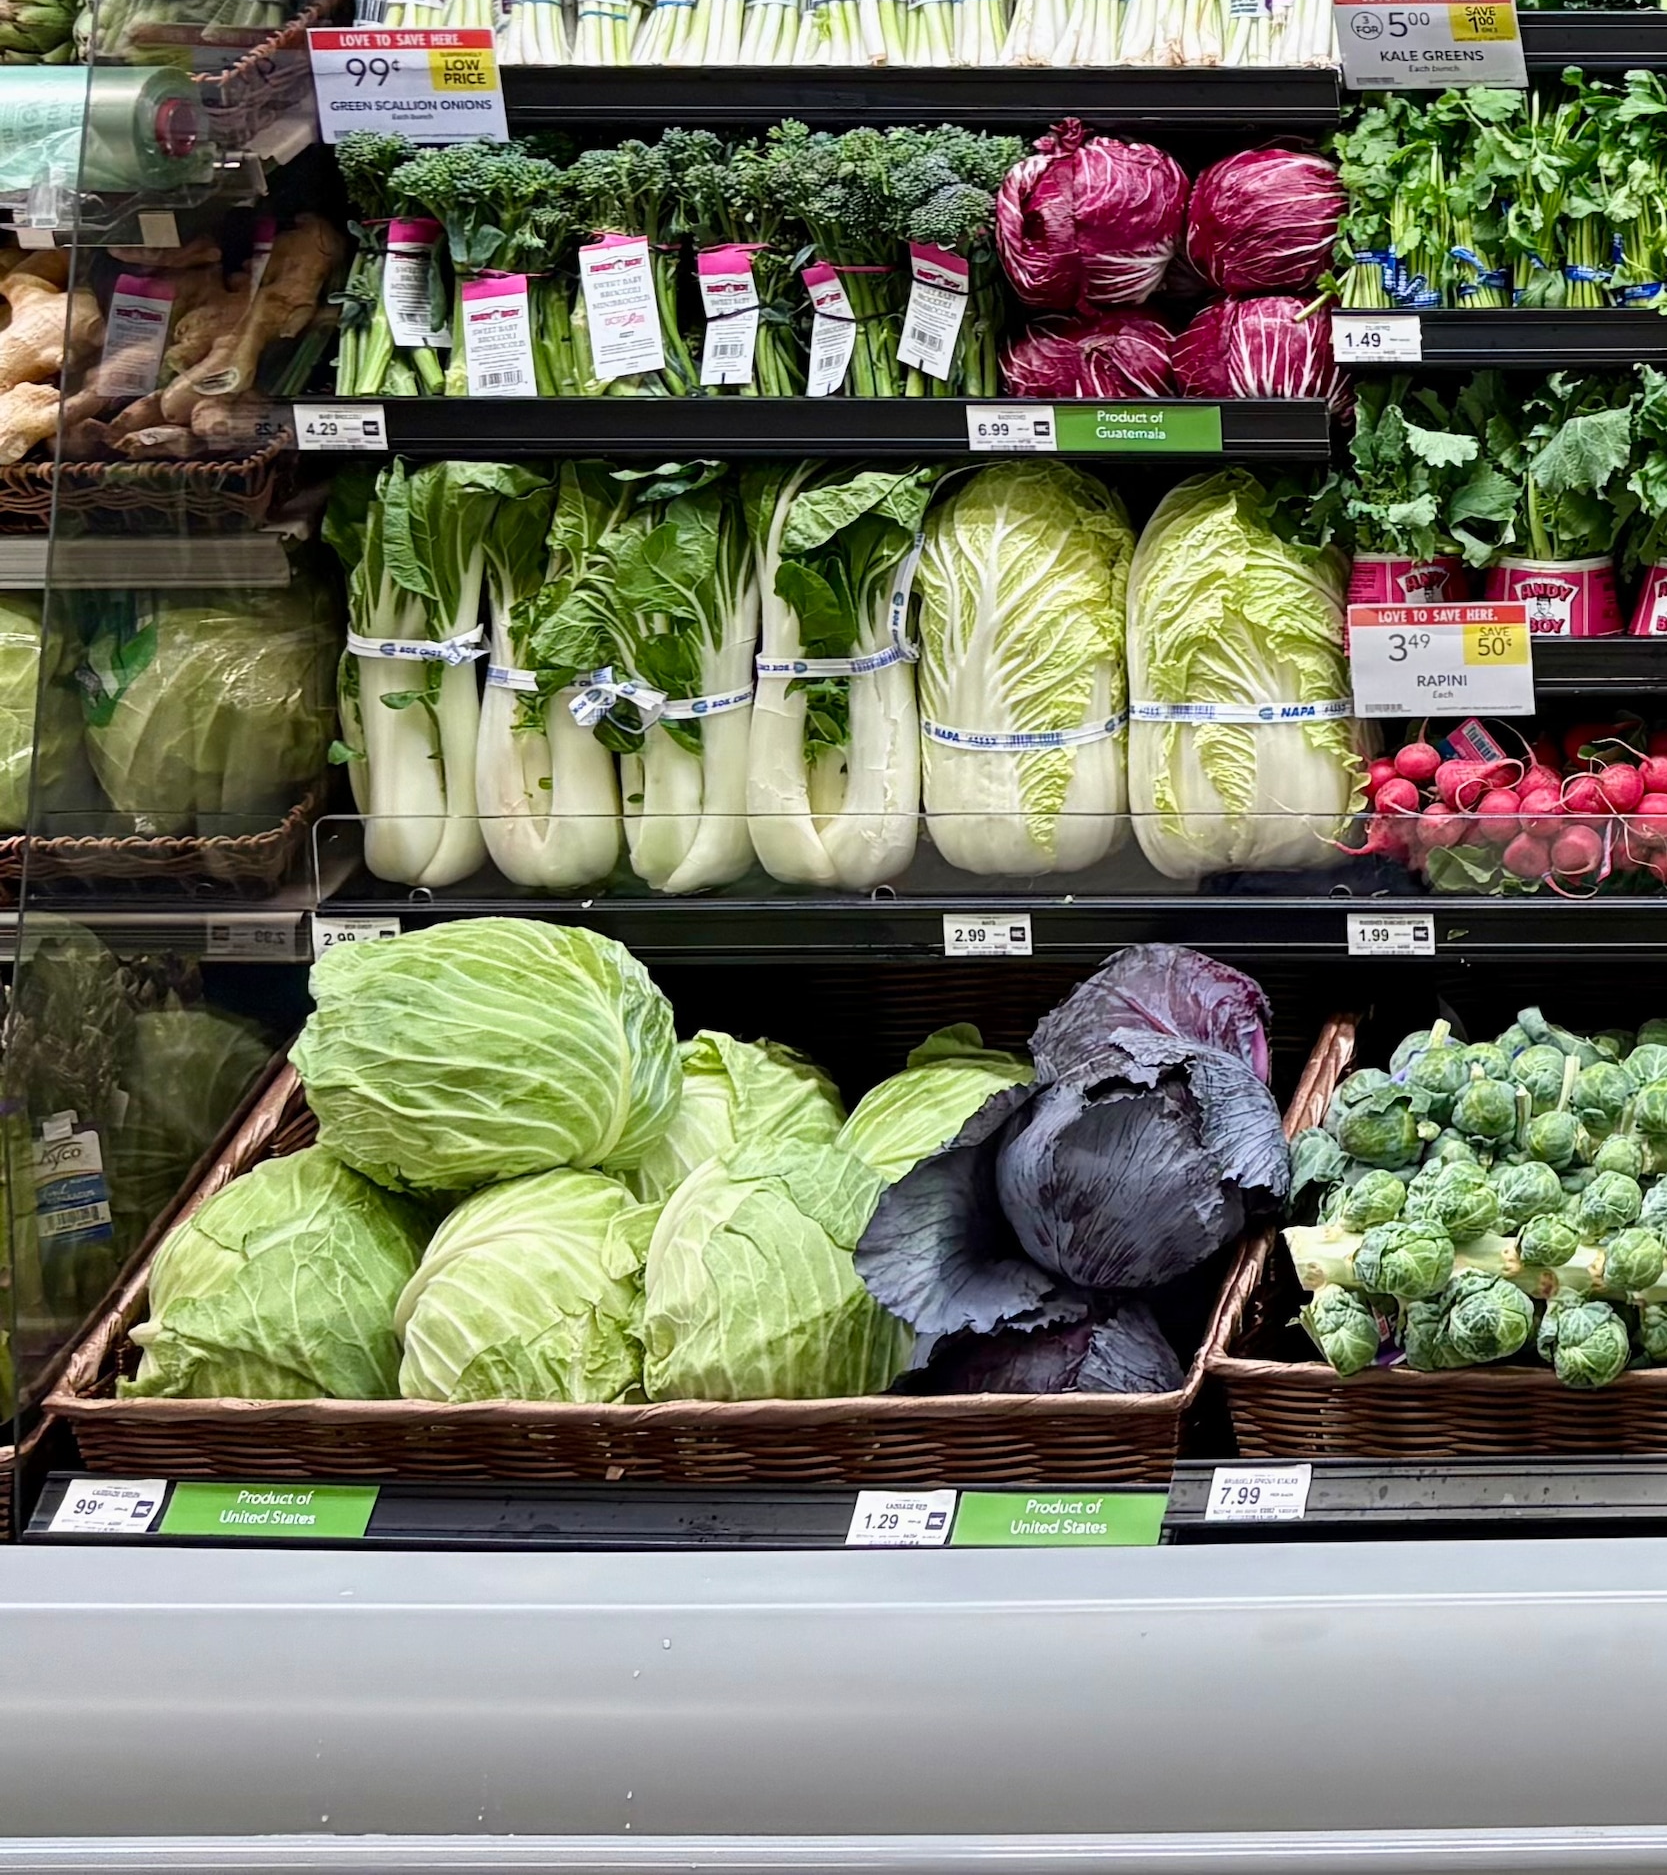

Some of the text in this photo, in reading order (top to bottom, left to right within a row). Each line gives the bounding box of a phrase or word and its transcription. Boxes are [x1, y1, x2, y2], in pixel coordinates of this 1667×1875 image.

[1465, 6, 1497, 17] SAVE
[1356, 25, 1380, 35] FOR
[340, 32, 464, 47] LOVE TO SAVE HERE.
[1379, 49, 1485, 62] KALE GREENS
[445, 59, 481, 72] LOW
[1408, 64, 1460, 73] Each bunch
[443, 73, 488, 85] PRICE
[329, 99, 493, 112] GREEN SCALLION ONIONS
[1344, 332, 1382, 348] 1.49
[1097, 409, 1165, 424] Product of
[305, 421, 338, 437] 4.29
[977, 422, 1010, 437] 6.99
[1095, 426, 1167, 441] Guatemala
[1520, 581, 1574, 601] ANDY
[1378, 608, 1499, 623] LOVE TO SAVE HERE.
[1479, 626, 1511, 637] SAVE
[1529, 617, 1566, 635] BOY
[1416, 674, 1469, 688] RAPINI
[1432, 689, 1454, 699] Each
[1280, 705, 1317, 718] NAPA
[934, 727, 961, 742] NAPA
[954, 928, 986, 943] 2.99
[1359, 928, 1390, 942] 1.99
[239, 1489, 319, 1507] Product of
[1219, 1486, 1262, 1505] 7.99
[74, 1497, 108, 1516] 99¢
[1025, 1497, 1105, 1515] Product of
[221, 1510, 319, 1526] United States
[863, 1513, 900, 1530] 1.29
[1009, 1519, 1109, 1535] United States
